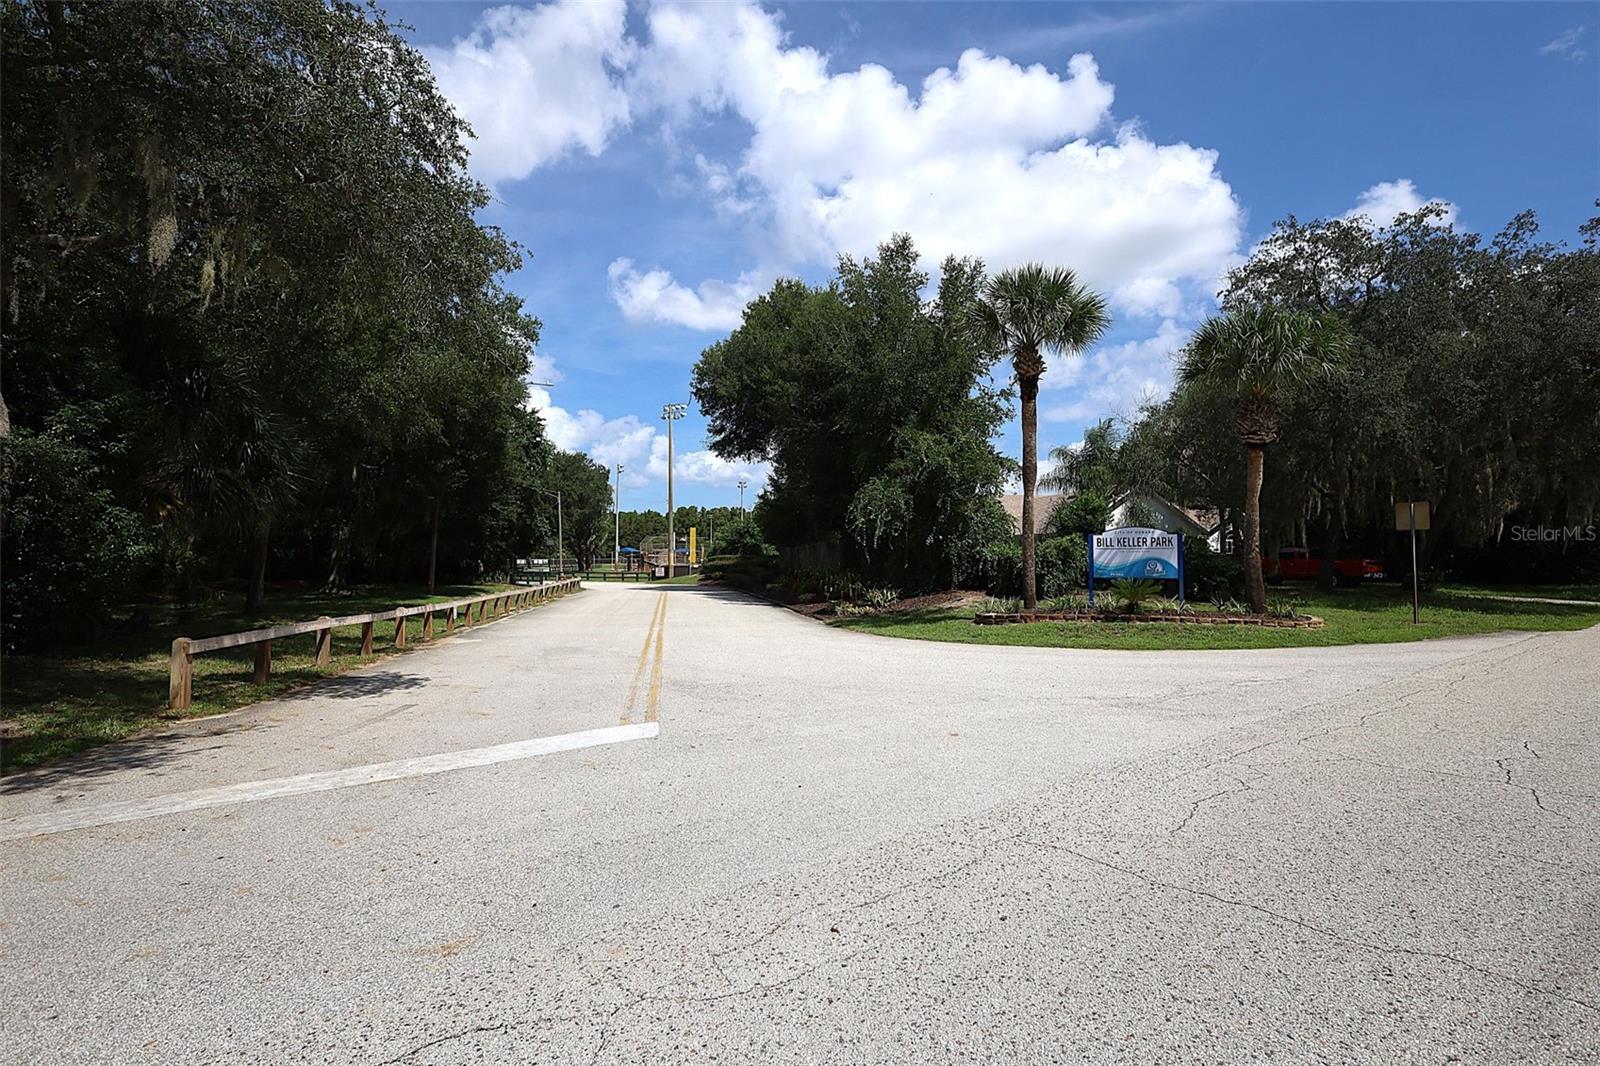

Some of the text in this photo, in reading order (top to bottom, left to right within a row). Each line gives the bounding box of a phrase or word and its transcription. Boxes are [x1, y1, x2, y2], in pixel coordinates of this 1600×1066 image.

[1096, 536, 1174, 548] BILL KELLER PARK
